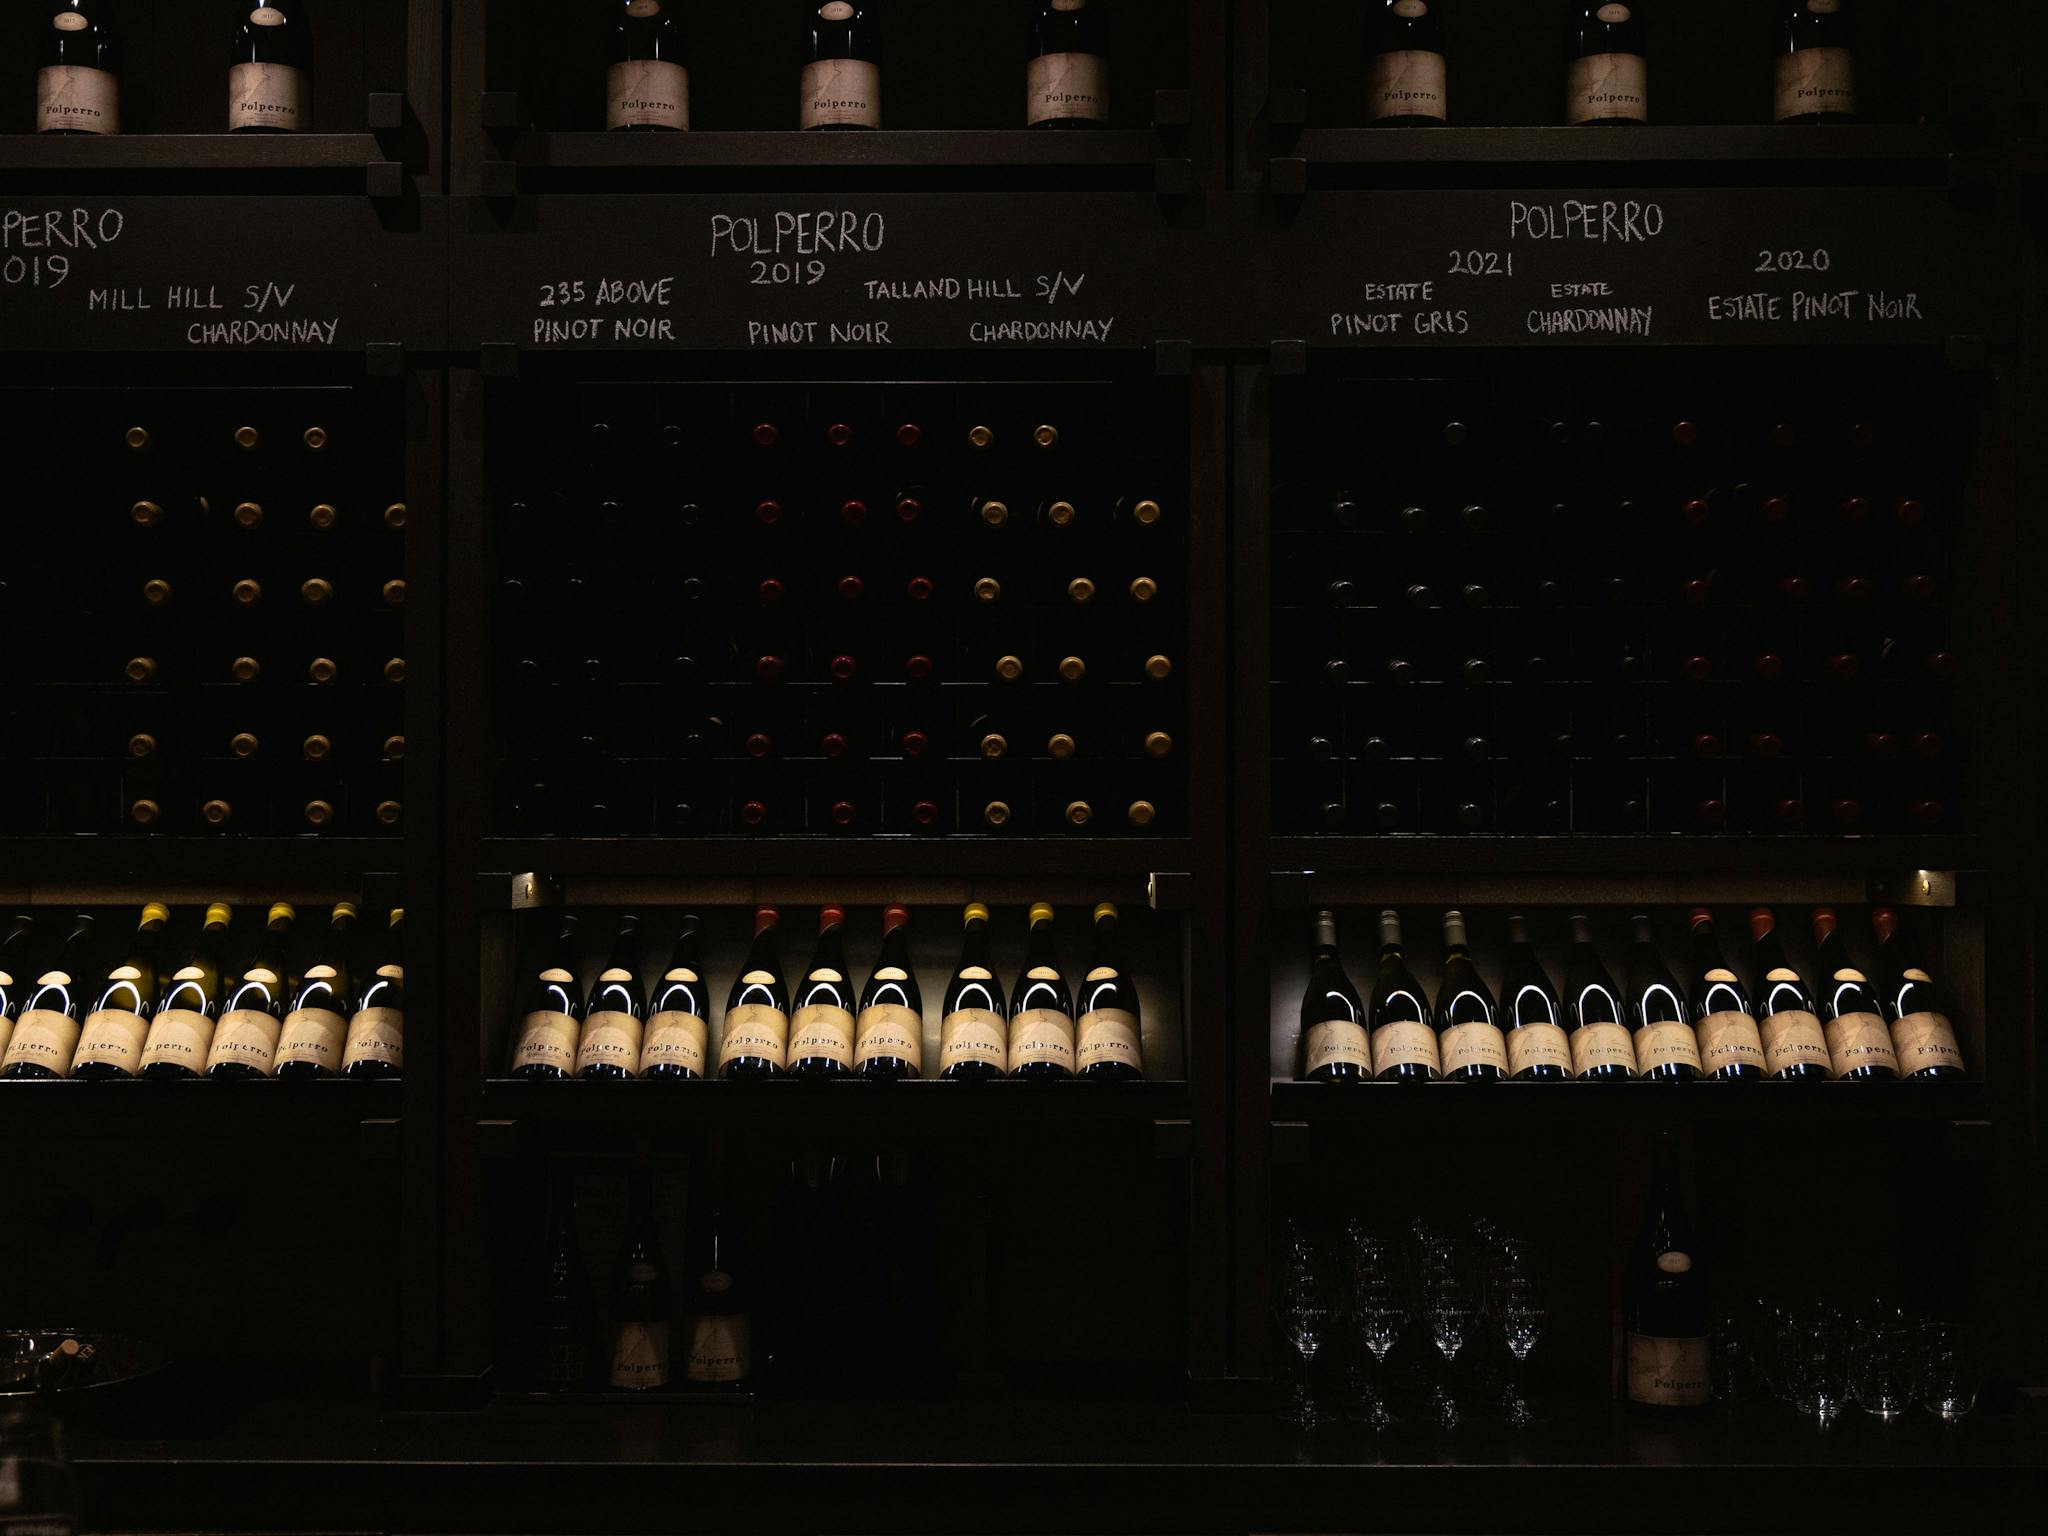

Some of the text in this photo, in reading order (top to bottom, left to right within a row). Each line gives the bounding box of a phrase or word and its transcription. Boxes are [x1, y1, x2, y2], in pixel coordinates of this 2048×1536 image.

[241, 101, 295, 114] Polperro
[621, 100, 675, 111] Polperro
[814, 98, 867, 109] Polperro
[1045, 92, 1098, 104] Polperro
[1384, 90, 1437, 101] Polperro
[1587, 93, 1641, 104] Polperro
[46, 104, 101, 117] Polperro
[711, 210, 885, 257] POLPERRO
[1510, 199, 1664, 243] POLPERRO
[750, 259, 826, 286] 2019
[1447, 249, 1513, 277] 2021
[1754, 248, 1830, 273] 2020
[89, 281, 295, 313] MILL HILL S/V
[539, 276, 675, 307] 235 ABOVE
[863, 271, 1085, 305] TALLAND HILL S/V
[1365, 280, 1433, 301] ESTATE
[1550, 281, 1613, 298] ESTATE
[1708, 292, 1781, 321] ESTATE
[1792, 290, 1856, 322] PINOT
[187, 318, 339, 345] CHARDONNAY
[533, 317, 676, 343] PINOT NOIR
[748, 320, 892, 346] PINOT NOIR
[969, 316, 1114, 343] CHARDONNAY
[1330, 310, 1469, 335] PINOT GRIS
[1527, 305, 1653, 337] CHARDONNAY
